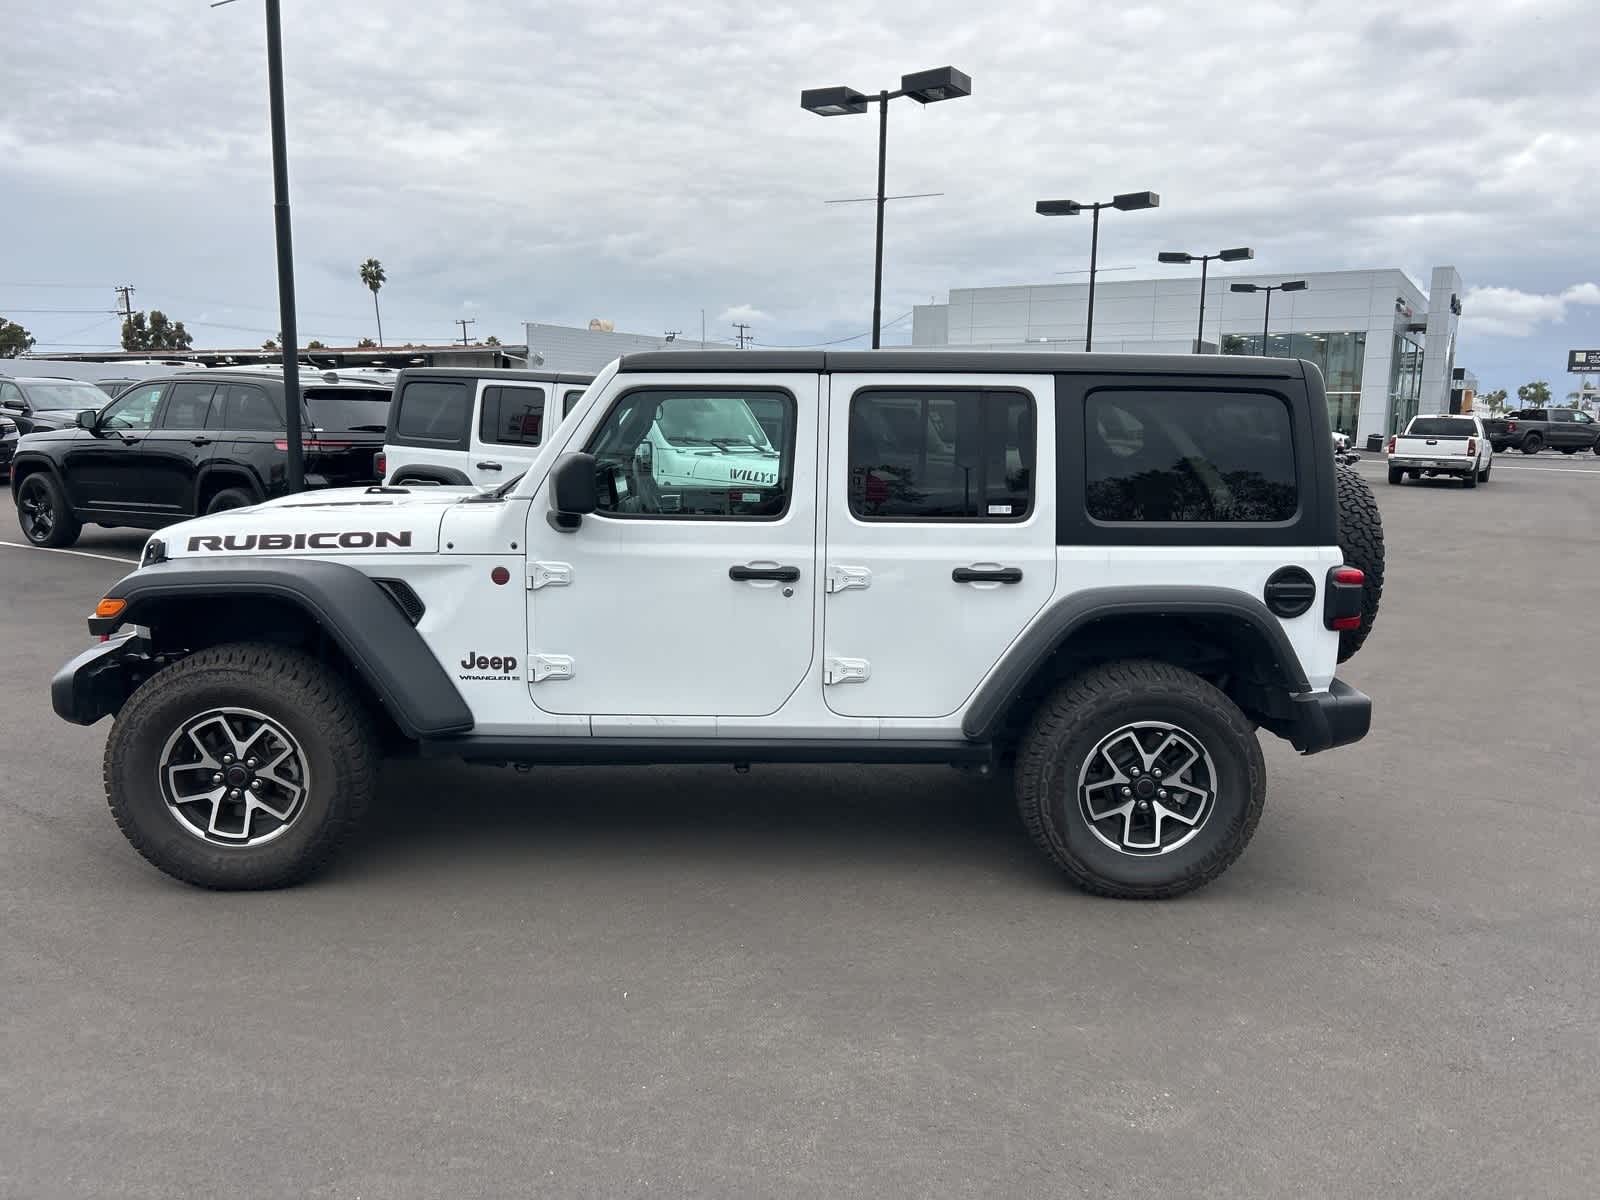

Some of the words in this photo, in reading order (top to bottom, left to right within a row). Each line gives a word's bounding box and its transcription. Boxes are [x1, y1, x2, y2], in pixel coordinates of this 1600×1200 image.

[730, 468, 777, 484] WILLYS
[187, 531, 412, 552] RUBICON
[461, 651, 517, 674] Jeep
